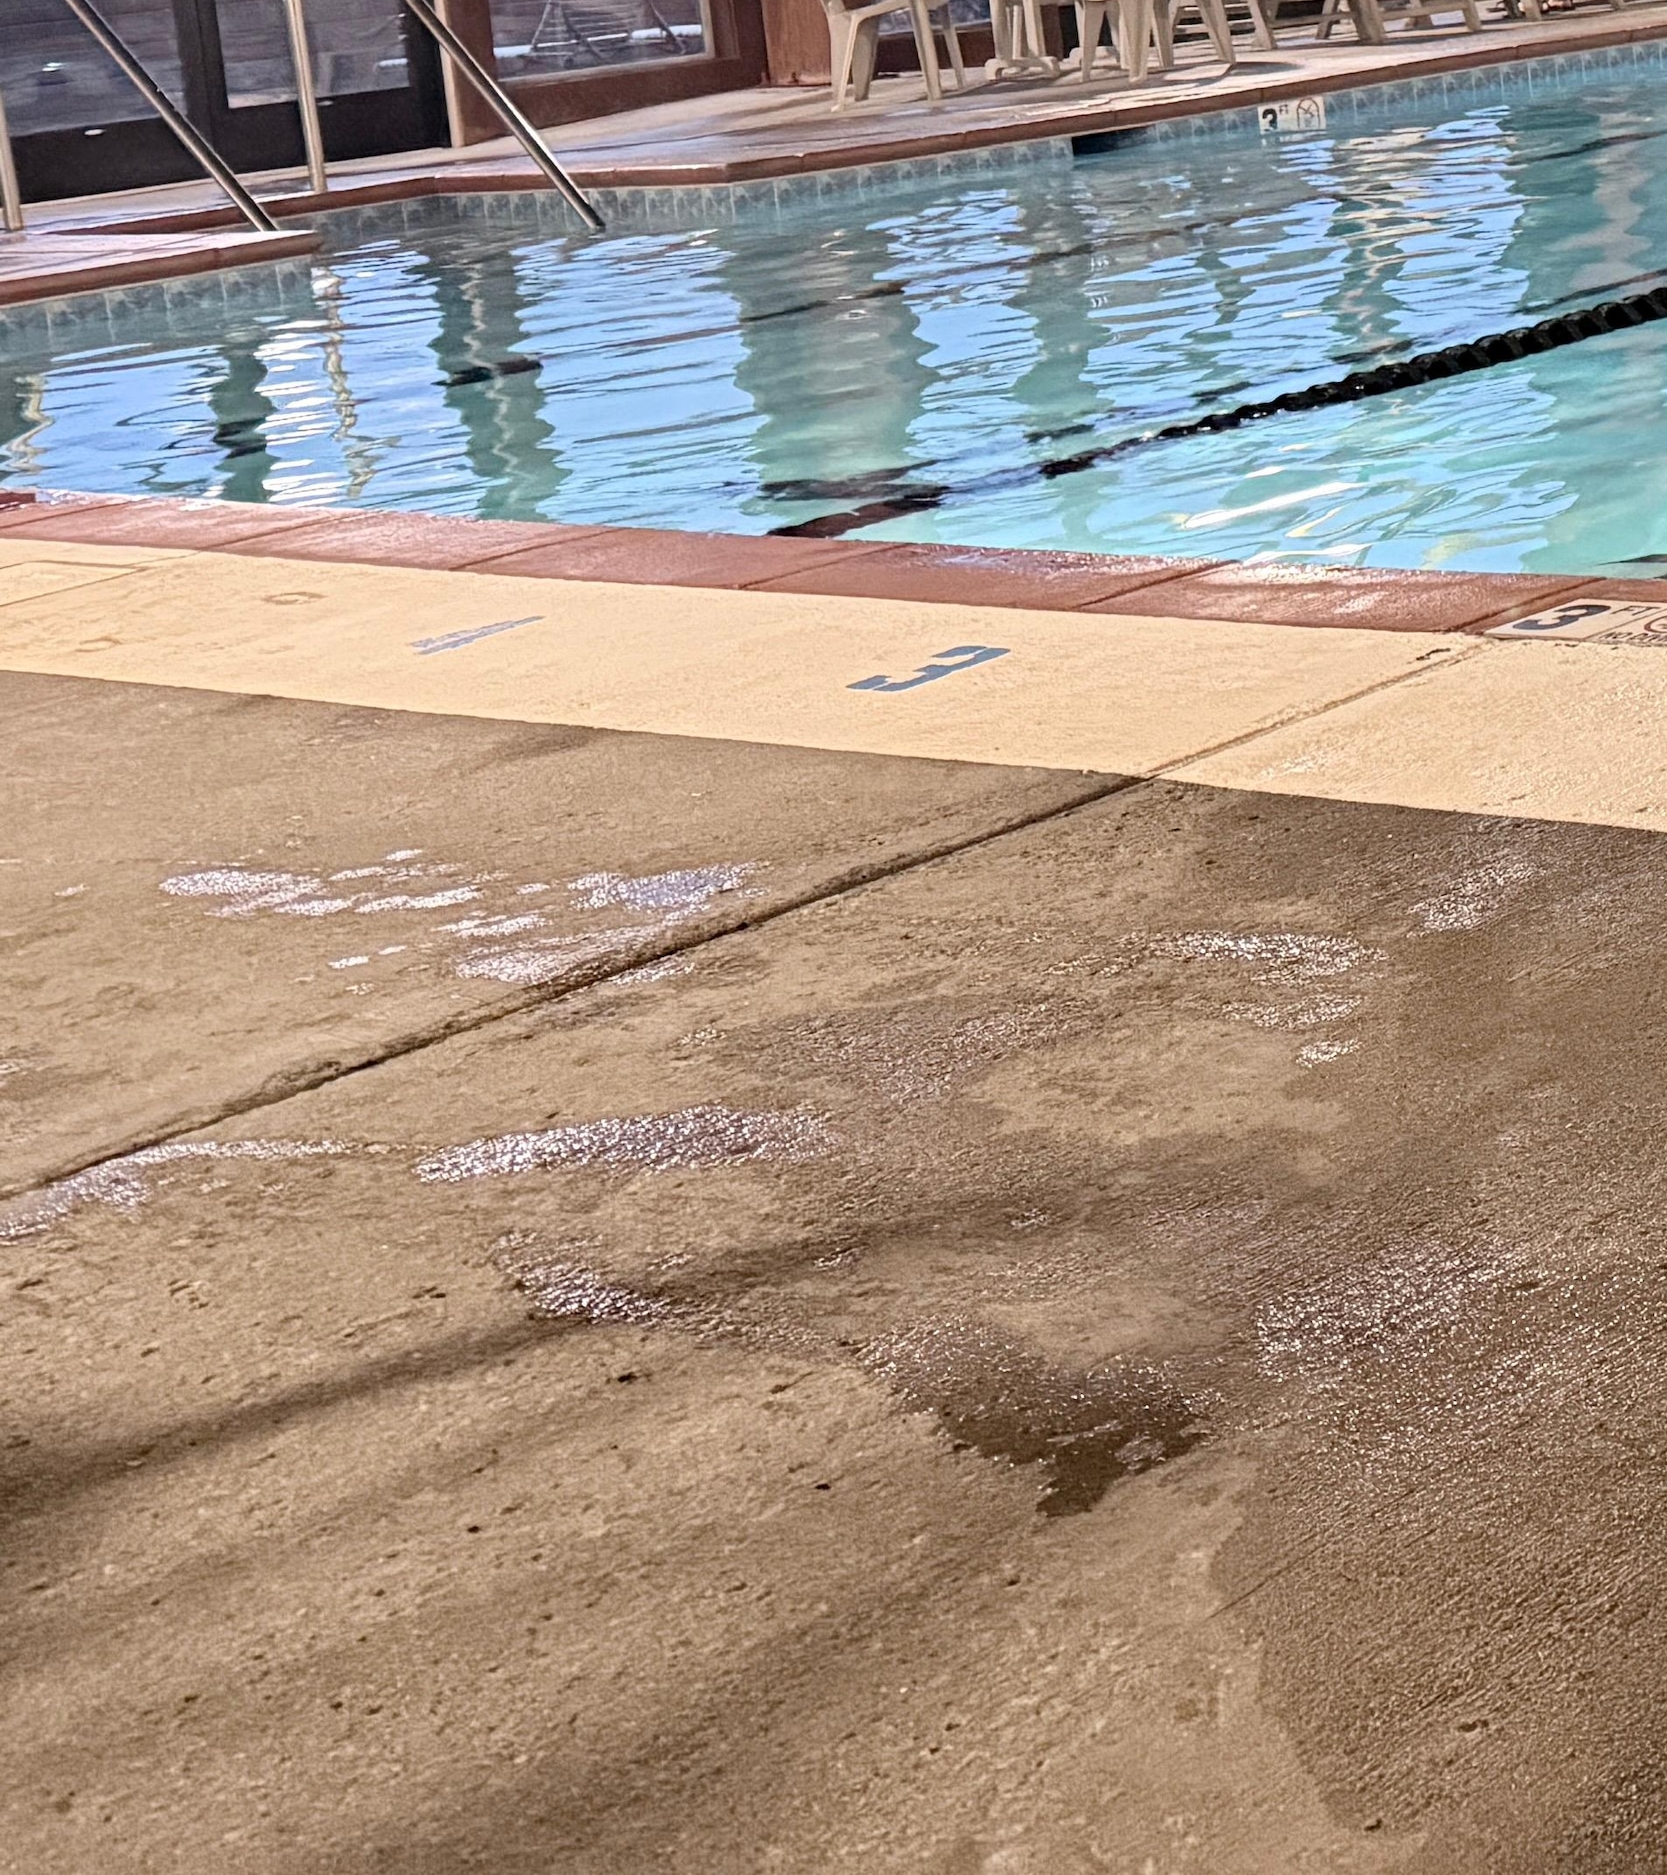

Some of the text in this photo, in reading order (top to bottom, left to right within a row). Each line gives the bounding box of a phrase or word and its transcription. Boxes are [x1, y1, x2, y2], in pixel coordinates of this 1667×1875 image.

[1511, 604, 1661, 631] 3 FT
[1600, 630, 1628, 640] NO
[845, 645, 1012, 692] 3
